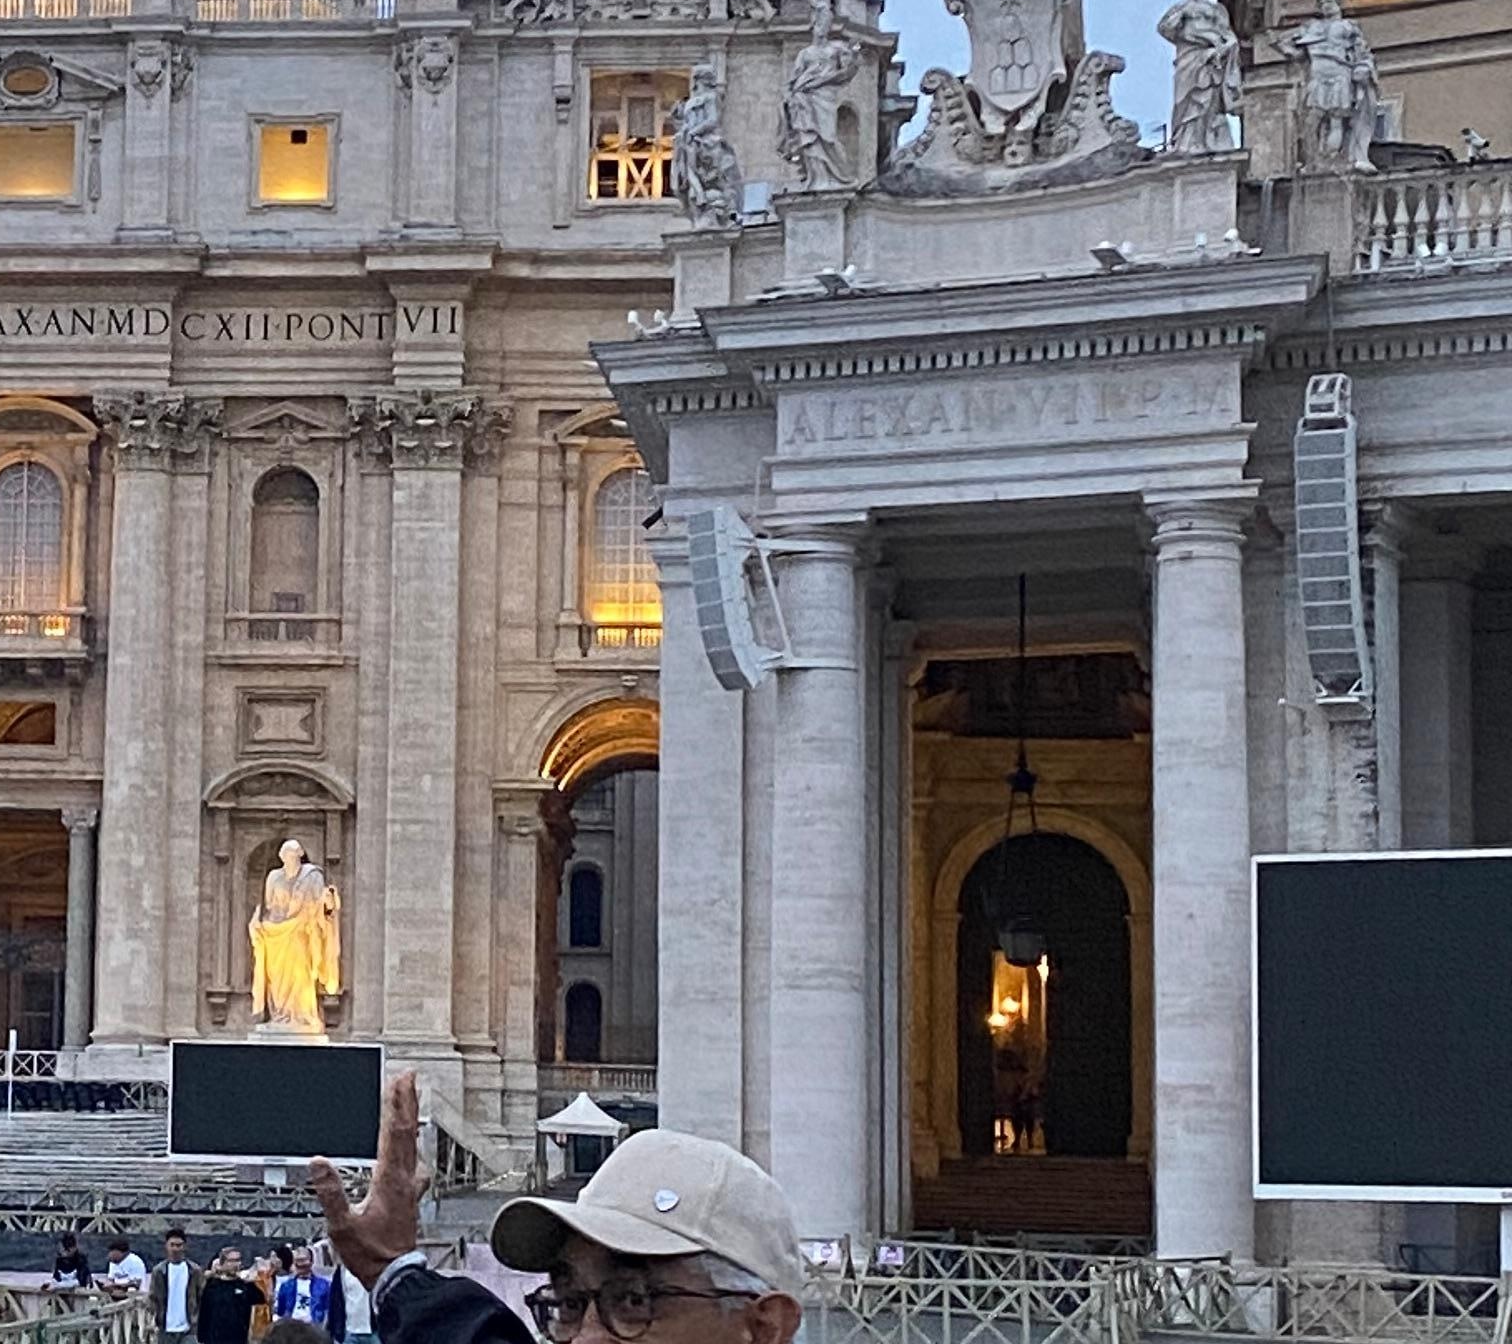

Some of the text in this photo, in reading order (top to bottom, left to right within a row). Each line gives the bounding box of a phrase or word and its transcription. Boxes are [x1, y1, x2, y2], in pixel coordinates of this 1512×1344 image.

[42, 307, 96, 336] AN
[284, 311, 390, 341] PONT
[397, 305, 459, 336] VII
